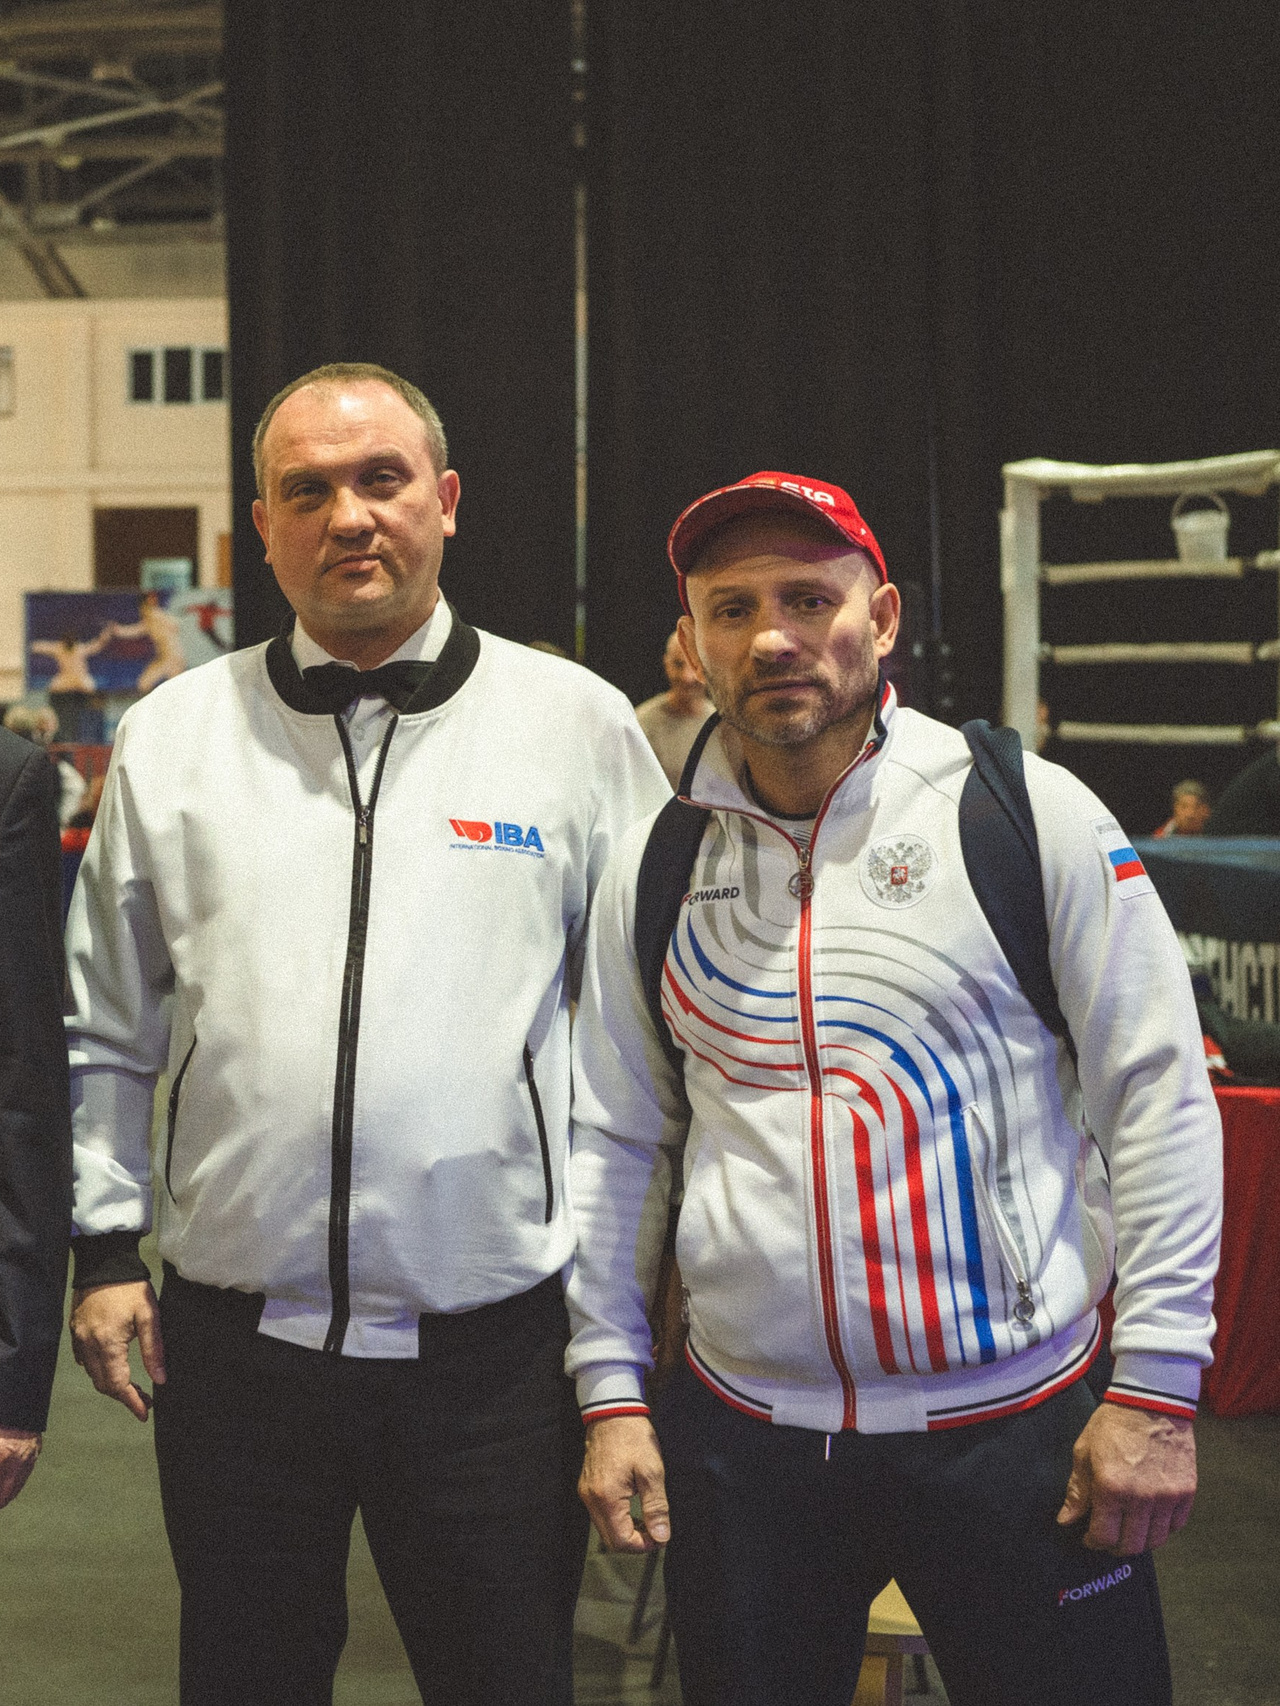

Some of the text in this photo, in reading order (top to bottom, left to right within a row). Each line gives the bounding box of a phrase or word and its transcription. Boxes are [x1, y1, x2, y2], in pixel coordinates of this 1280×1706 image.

[449, 843, 493, 852] INTERNATIONAL
[493, 844, 515, 854] BOXING
[494, 821, 545, 852] IBA
[1058, 1563, 1132, 1606] FORWARD
